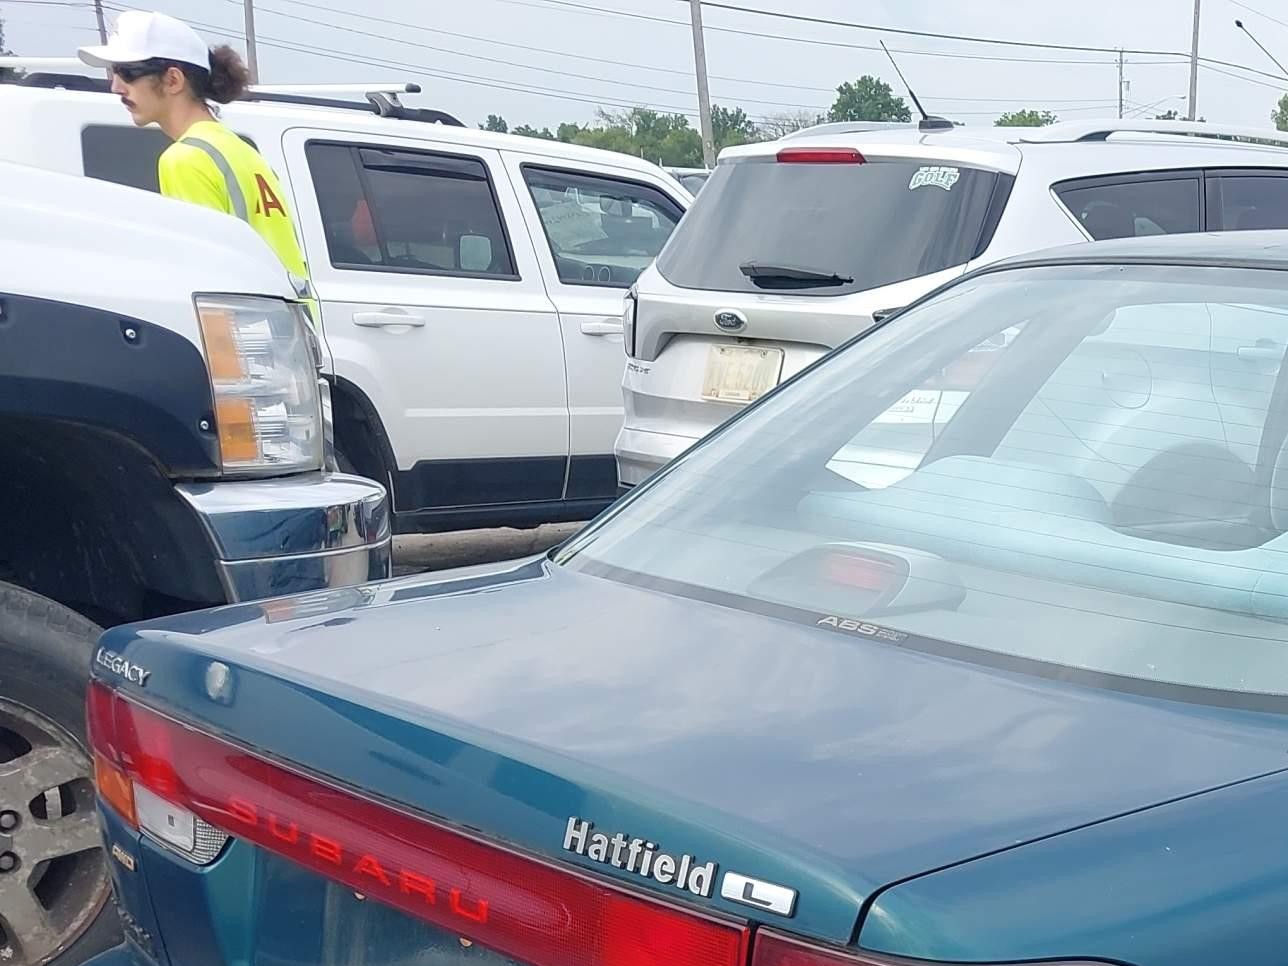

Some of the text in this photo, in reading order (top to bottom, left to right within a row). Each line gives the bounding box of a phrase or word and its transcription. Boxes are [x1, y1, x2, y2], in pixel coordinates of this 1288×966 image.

[255, 173, 287, 217] A
[909, 171, 960, 191] GOLF
[816, 615, 880, 635] ABS
[96, 647, 151, 686] LEGACY
[227, 796, 489, 924] SUBARU
[562, 815, 773, 907] Hatfield L
